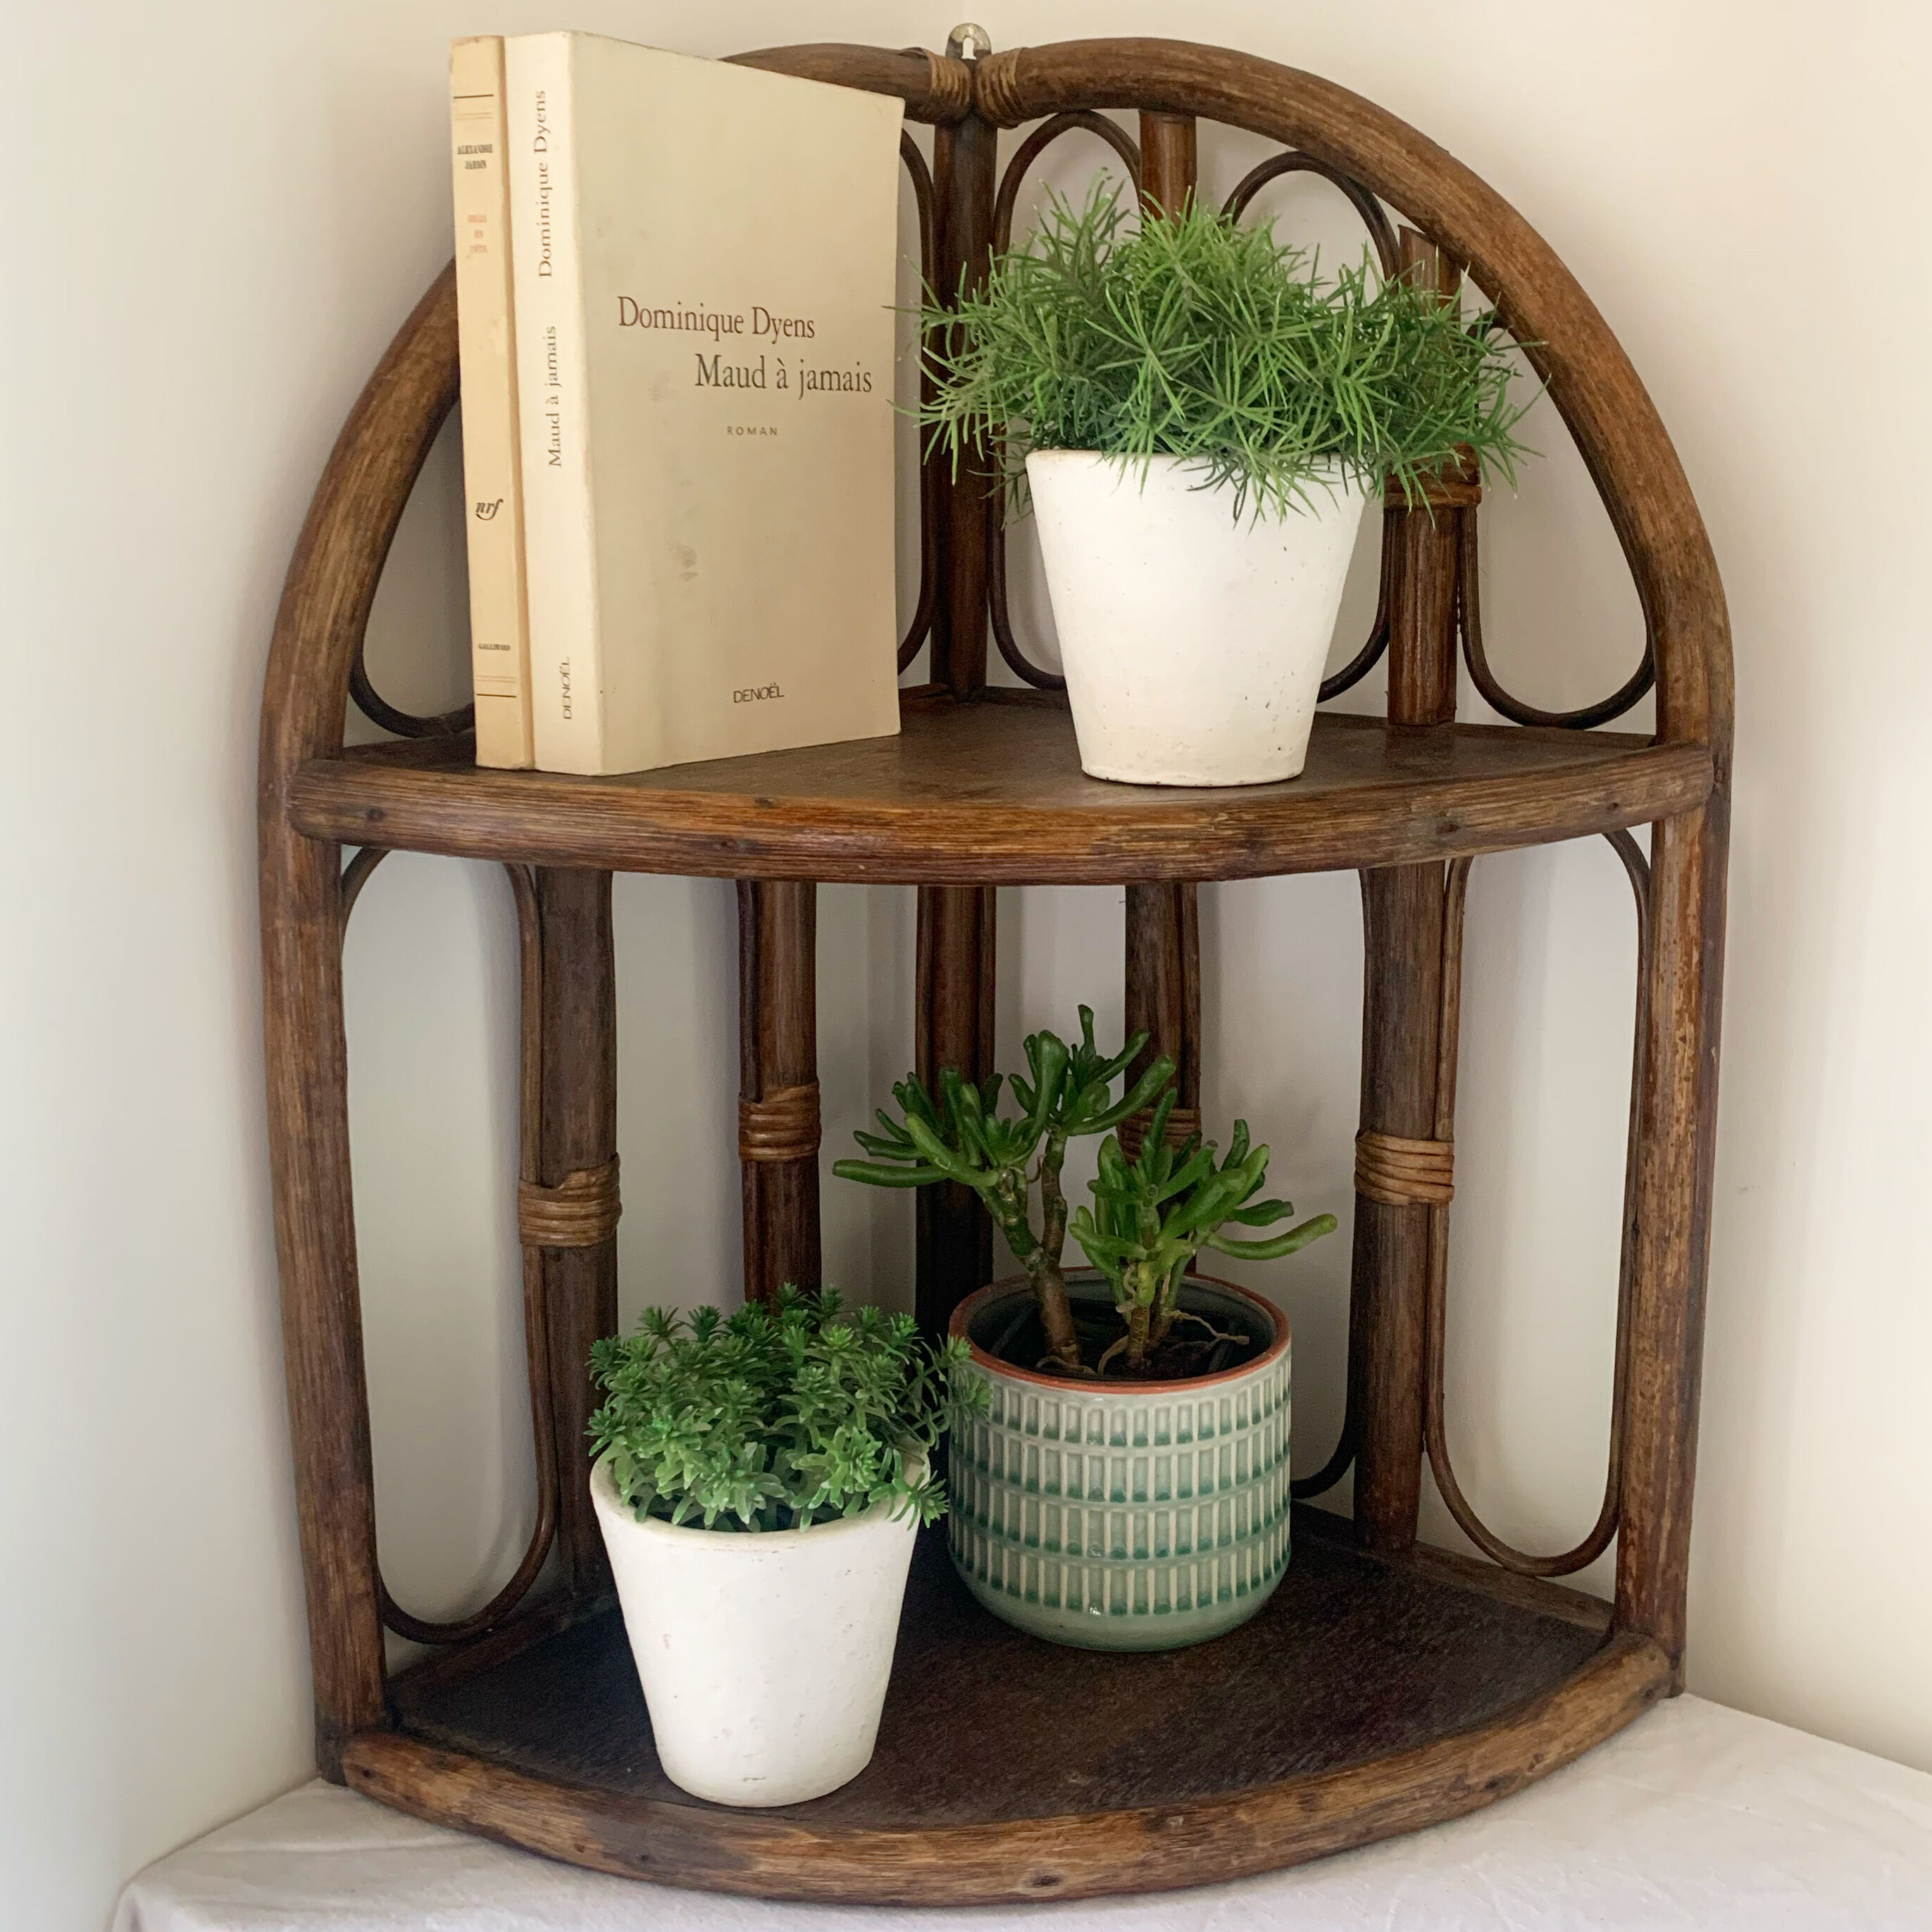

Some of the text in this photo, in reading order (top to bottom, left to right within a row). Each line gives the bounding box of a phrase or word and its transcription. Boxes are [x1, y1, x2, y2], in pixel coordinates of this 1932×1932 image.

[534, 89, 553, 278] Dominique Dyens
[617, 296, 815, 344] Dominique Dyens
[542, 325, 563, 468] Maud à jamais
[694, 353, 873, 400] Maud à jamais
[727, 425, 778, 436] ROMAN
[475, 498, 504, 521] nrf
[559, 656, 572, 720] DENOËL
[733, 682, 785, 703] DENOËL
